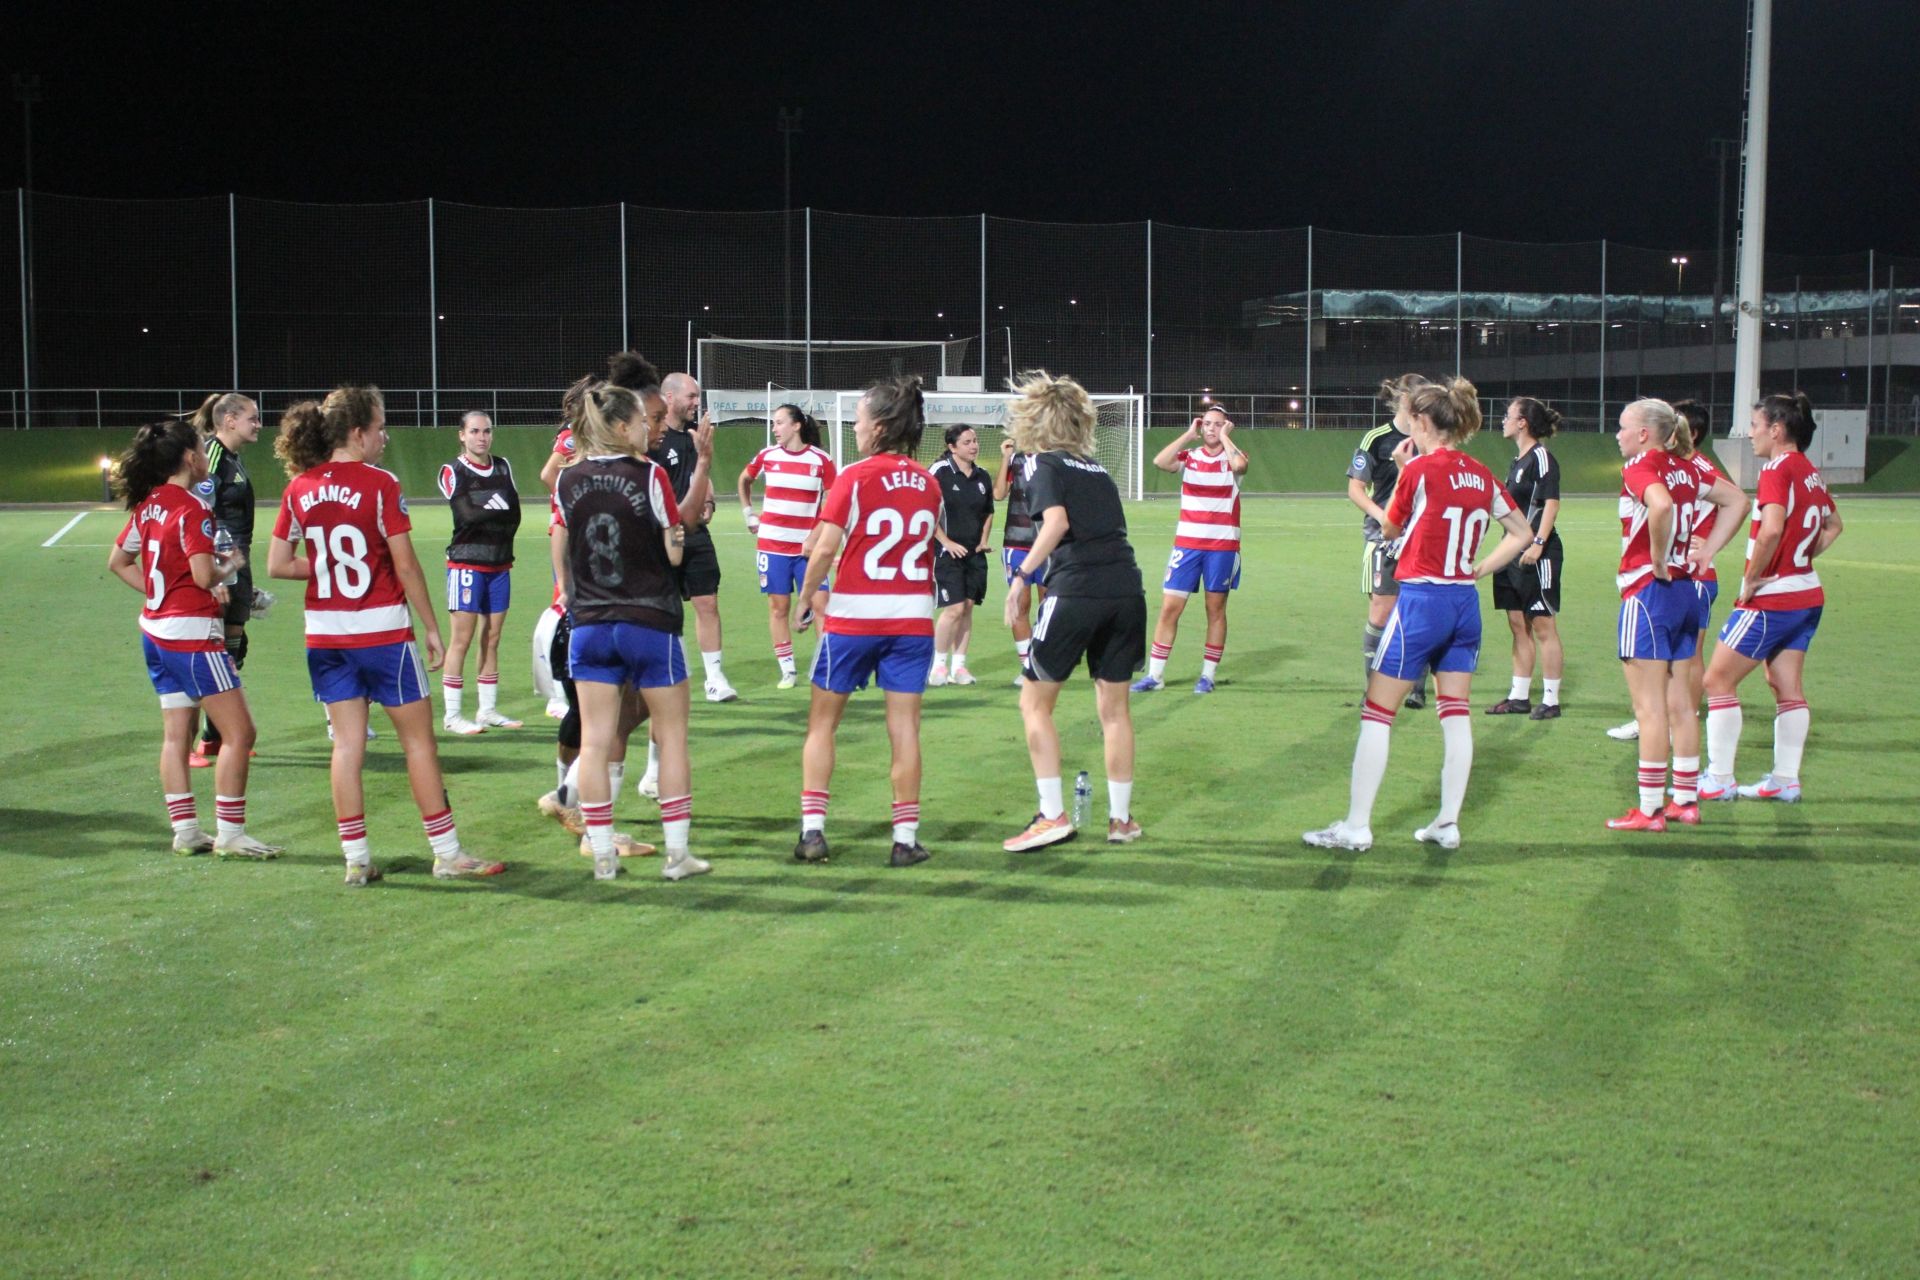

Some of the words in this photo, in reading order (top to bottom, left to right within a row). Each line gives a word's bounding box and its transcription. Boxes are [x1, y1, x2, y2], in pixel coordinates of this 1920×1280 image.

[300, 485, 362, 512] BLANCA
[881, 470, 926, 492] LELES
[1449, 472, 1485, 492] LAURI
[147, 540, 165, 610] 3
[305, 524, 371, 599] 18
[586, 513, 622, 587] 8
[864, 507, 935, 580] 22
[1442, 506, 1489, 576] 10
[461, 569, 473, 587] 6
